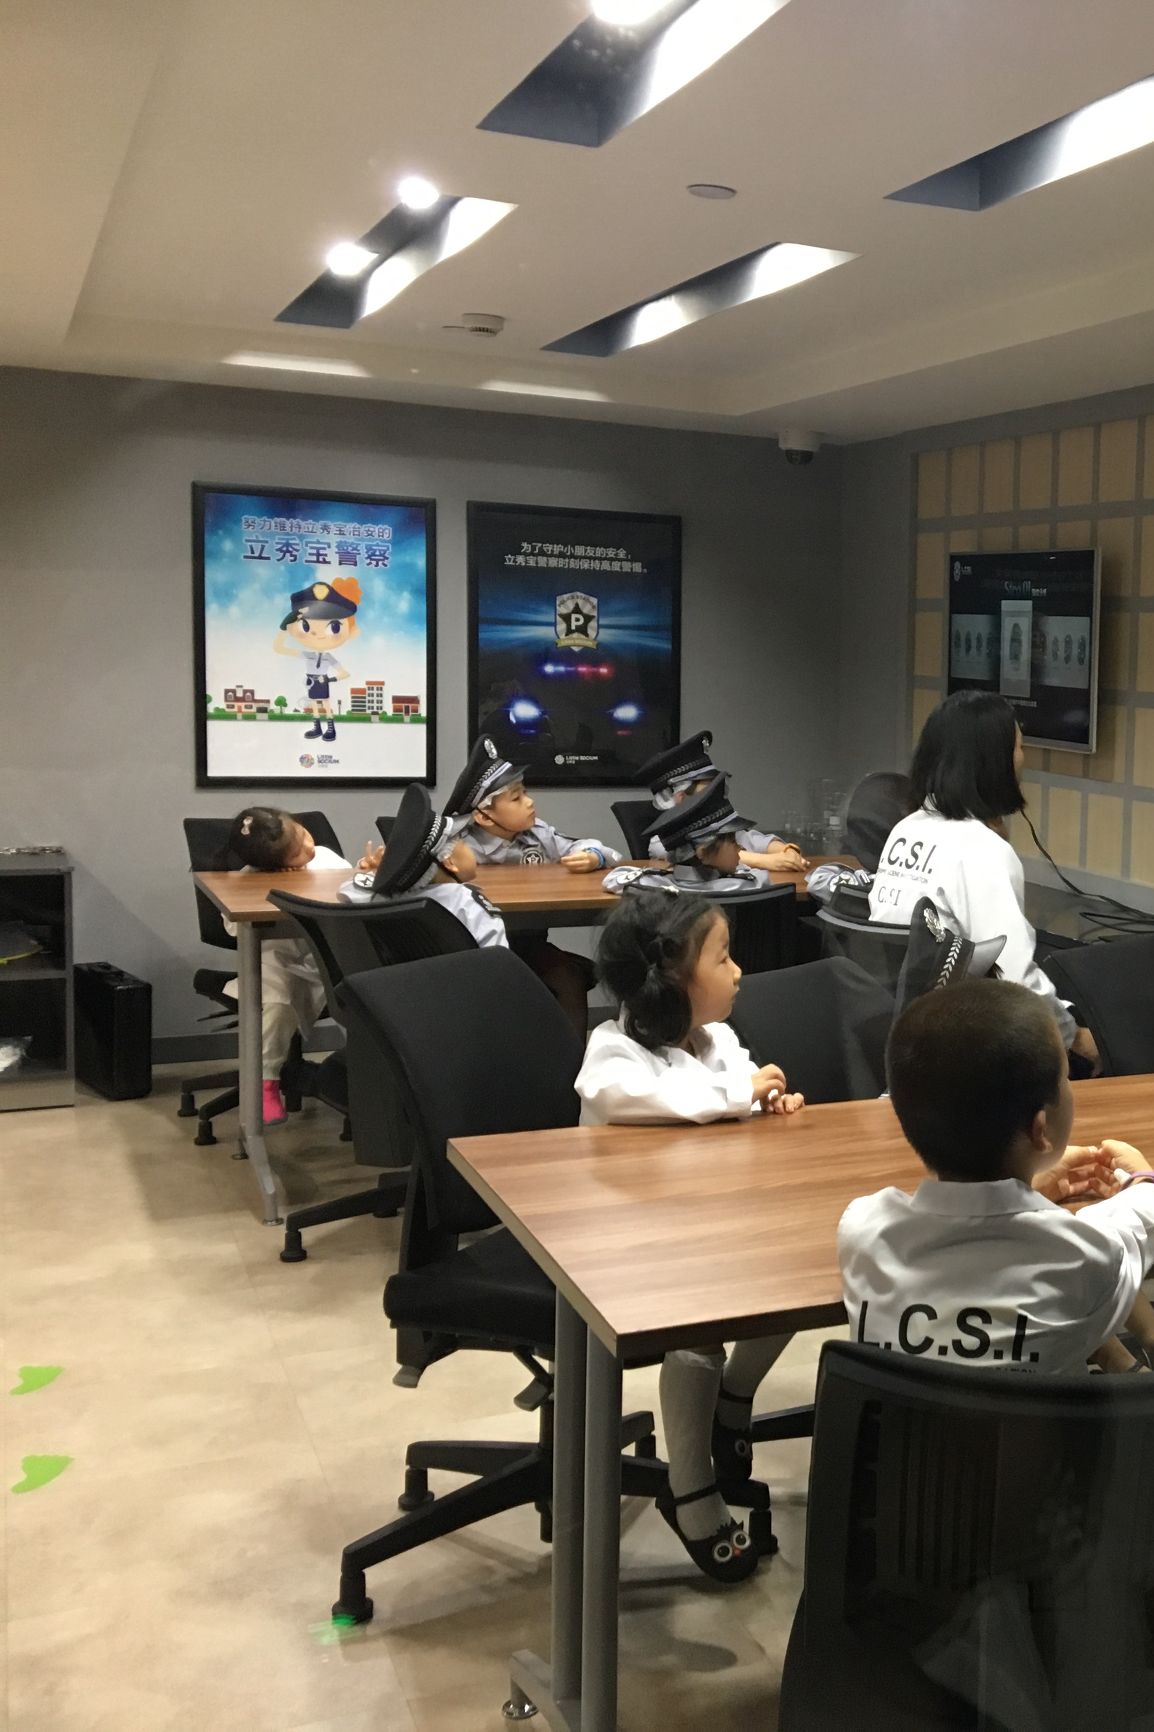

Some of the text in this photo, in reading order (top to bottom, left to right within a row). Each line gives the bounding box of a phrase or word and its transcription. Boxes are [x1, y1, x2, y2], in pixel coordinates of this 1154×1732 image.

[243, 516, 391, 538] 努力维持立秀宝治安的
[243, 536, 391, 567] 立秀宝警察
[570, 613, 585, 630] P
[880, 837, 937, 874] .C.S.I.
[858, 1301, 1040, 1362] L.C.S.I.
